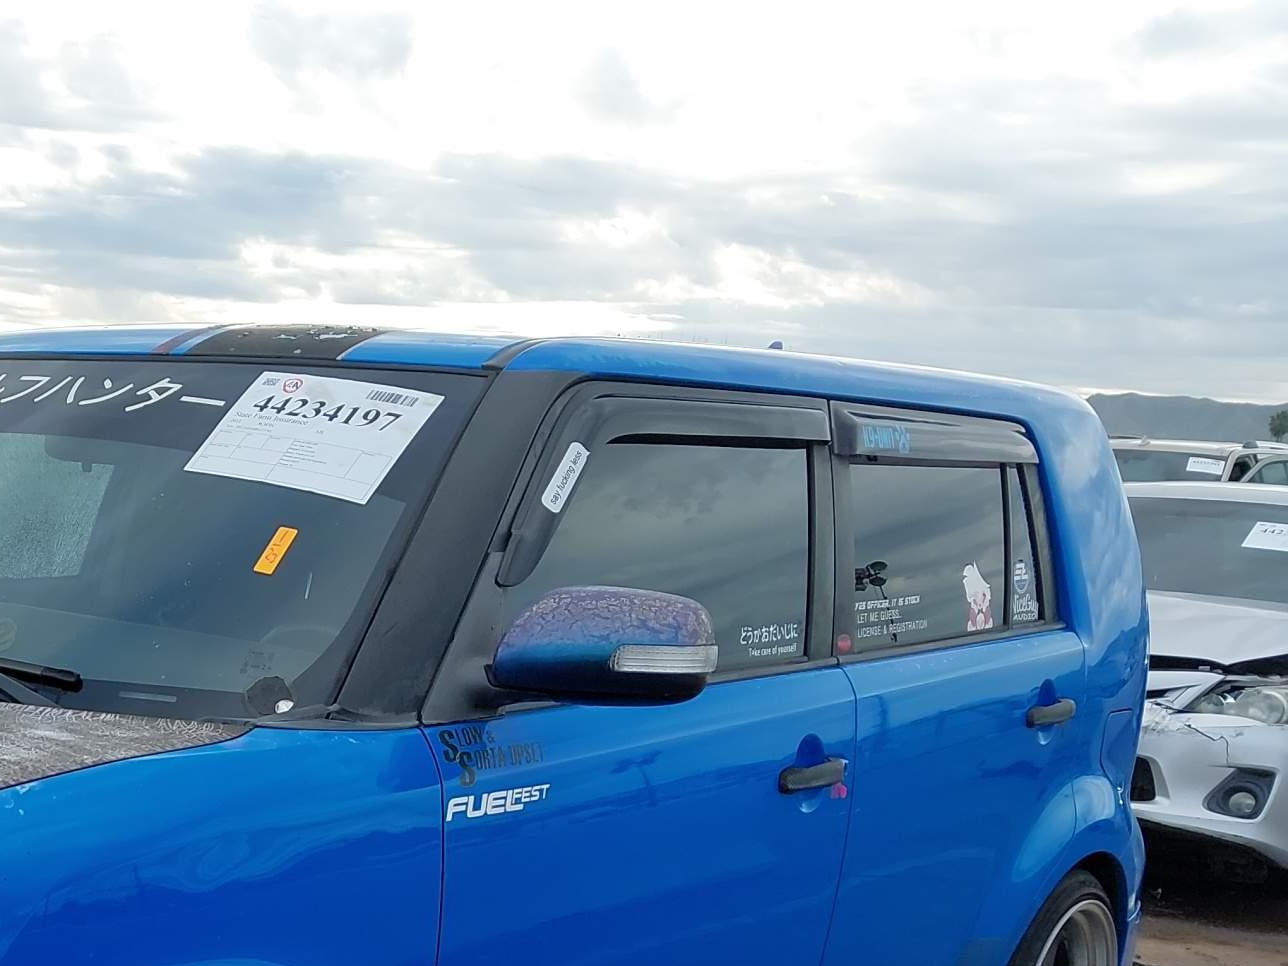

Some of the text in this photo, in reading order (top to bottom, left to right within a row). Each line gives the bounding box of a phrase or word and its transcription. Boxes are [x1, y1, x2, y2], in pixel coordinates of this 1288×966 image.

[253, 395, 403, 431] 44234197
[857, 613, 867, 624] LET
[869, 612, 879, 622] ME
[740, 623, 798, 645] どうかおだいじに
[857, 626, 881, 638] LICENSE
[889, 620, 928, 634] REGISTRATION
